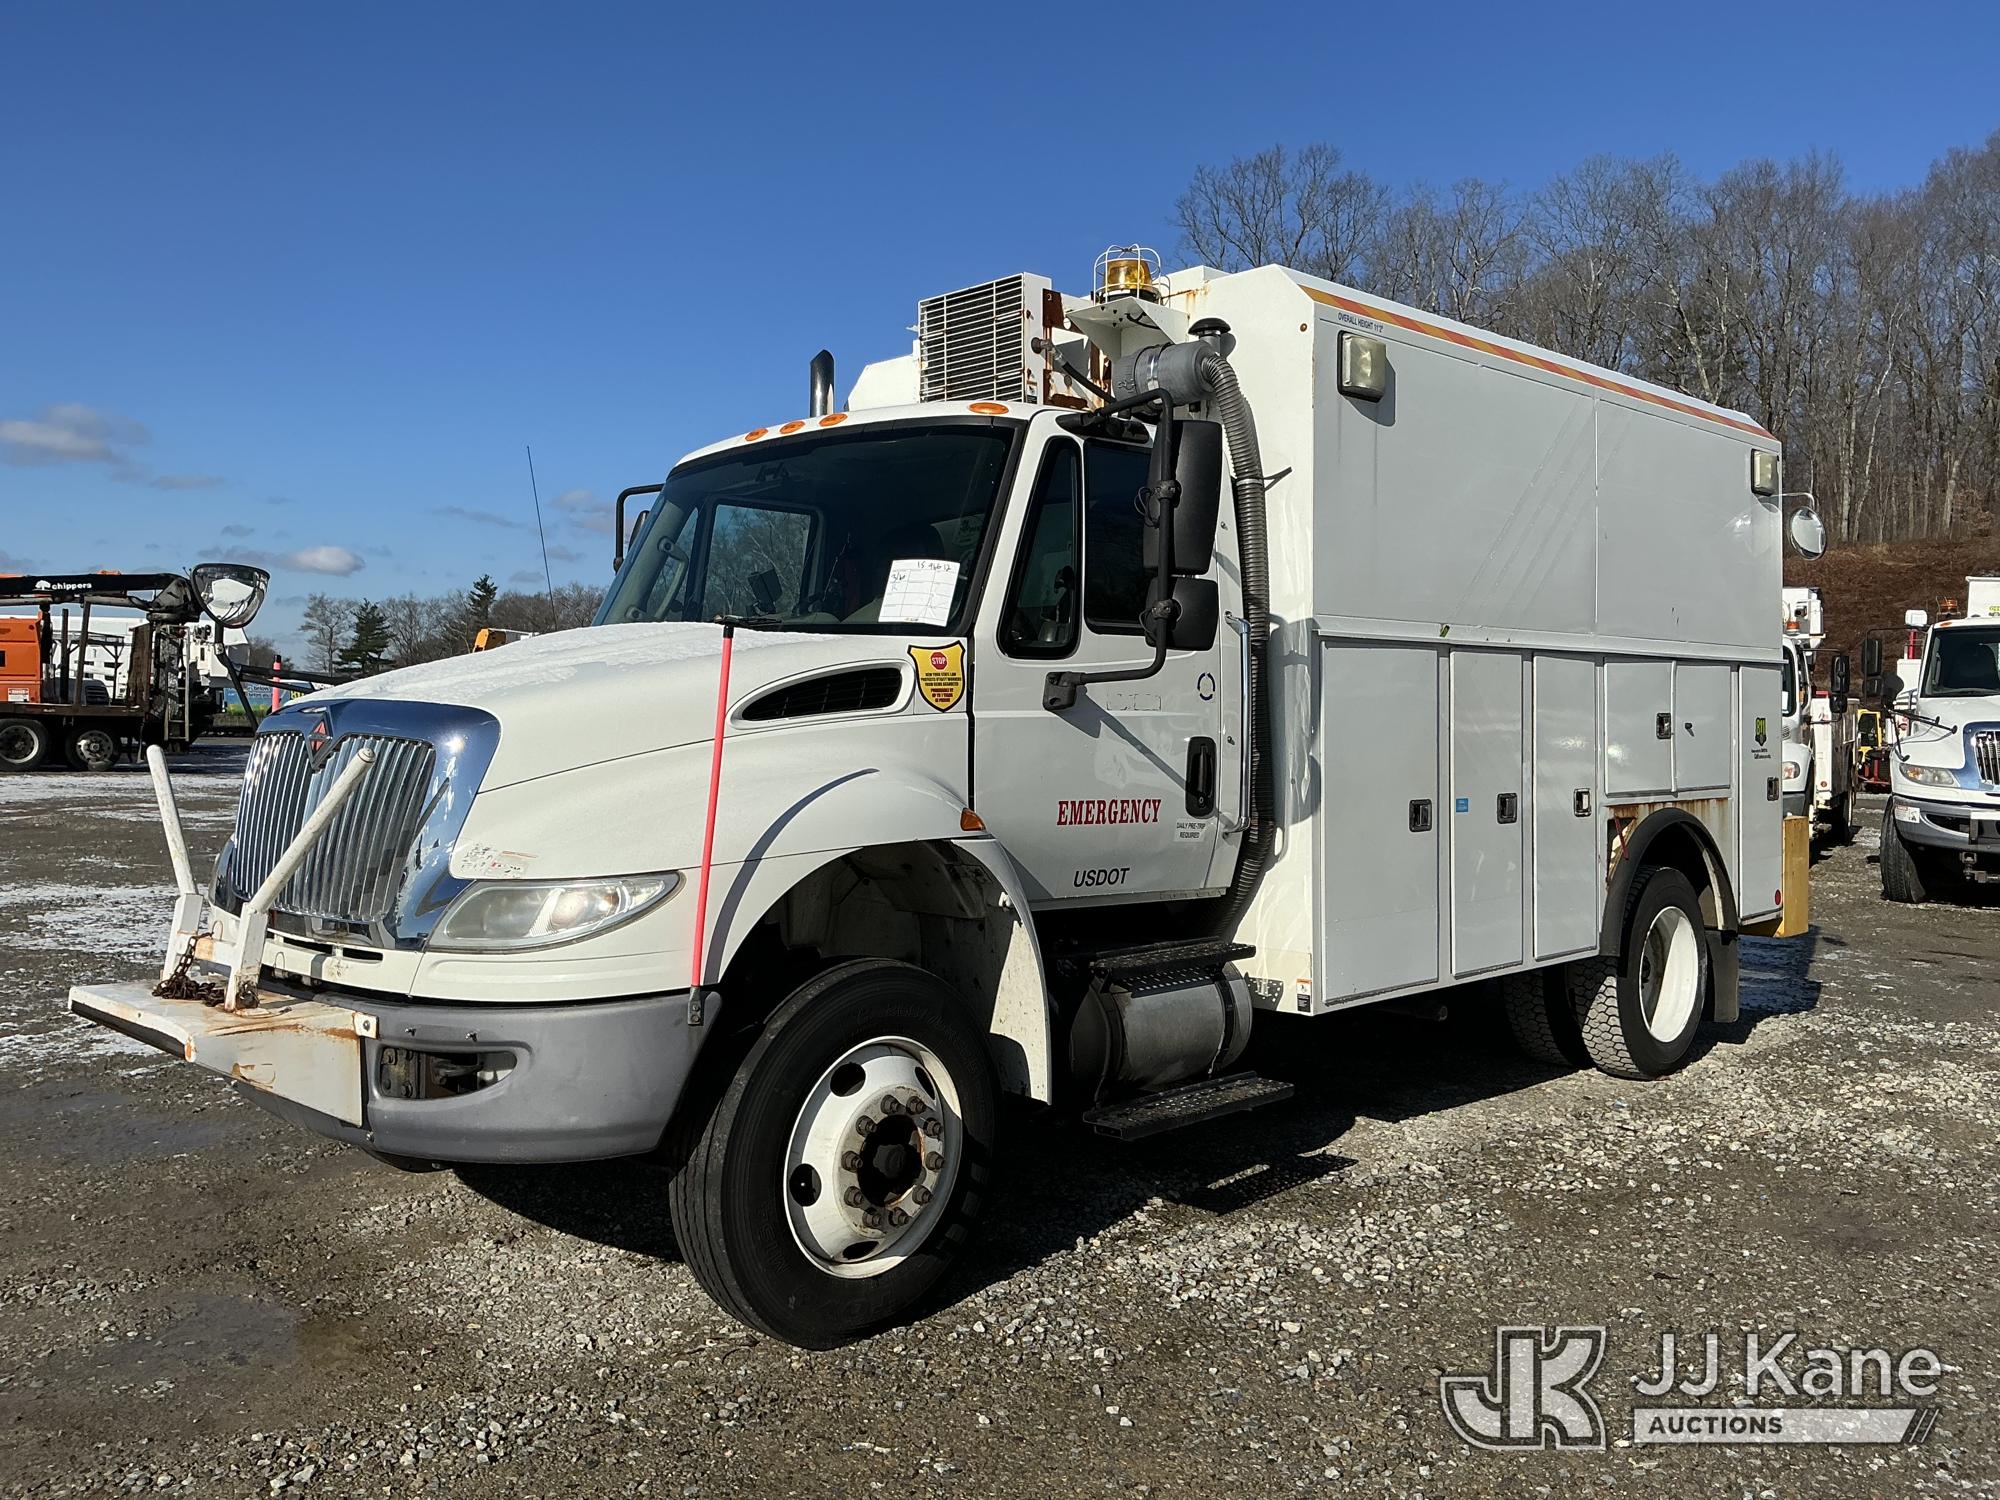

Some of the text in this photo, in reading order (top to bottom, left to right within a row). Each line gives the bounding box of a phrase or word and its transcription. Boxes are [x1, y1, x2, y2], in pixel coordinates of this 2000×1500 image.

[1338, 312, 1357, 326] OVERALL
[1358, 318, 1374, 330] HEIGHT
[51, 582, 92, 591] chippers
[931, 657, 946, 666] STOP
[1057, 799, 1162, 826] EMERGENCY
[1179, 831, 1200, 839] REQUIRED
[1073, 867, 1130, 887] USDOT
